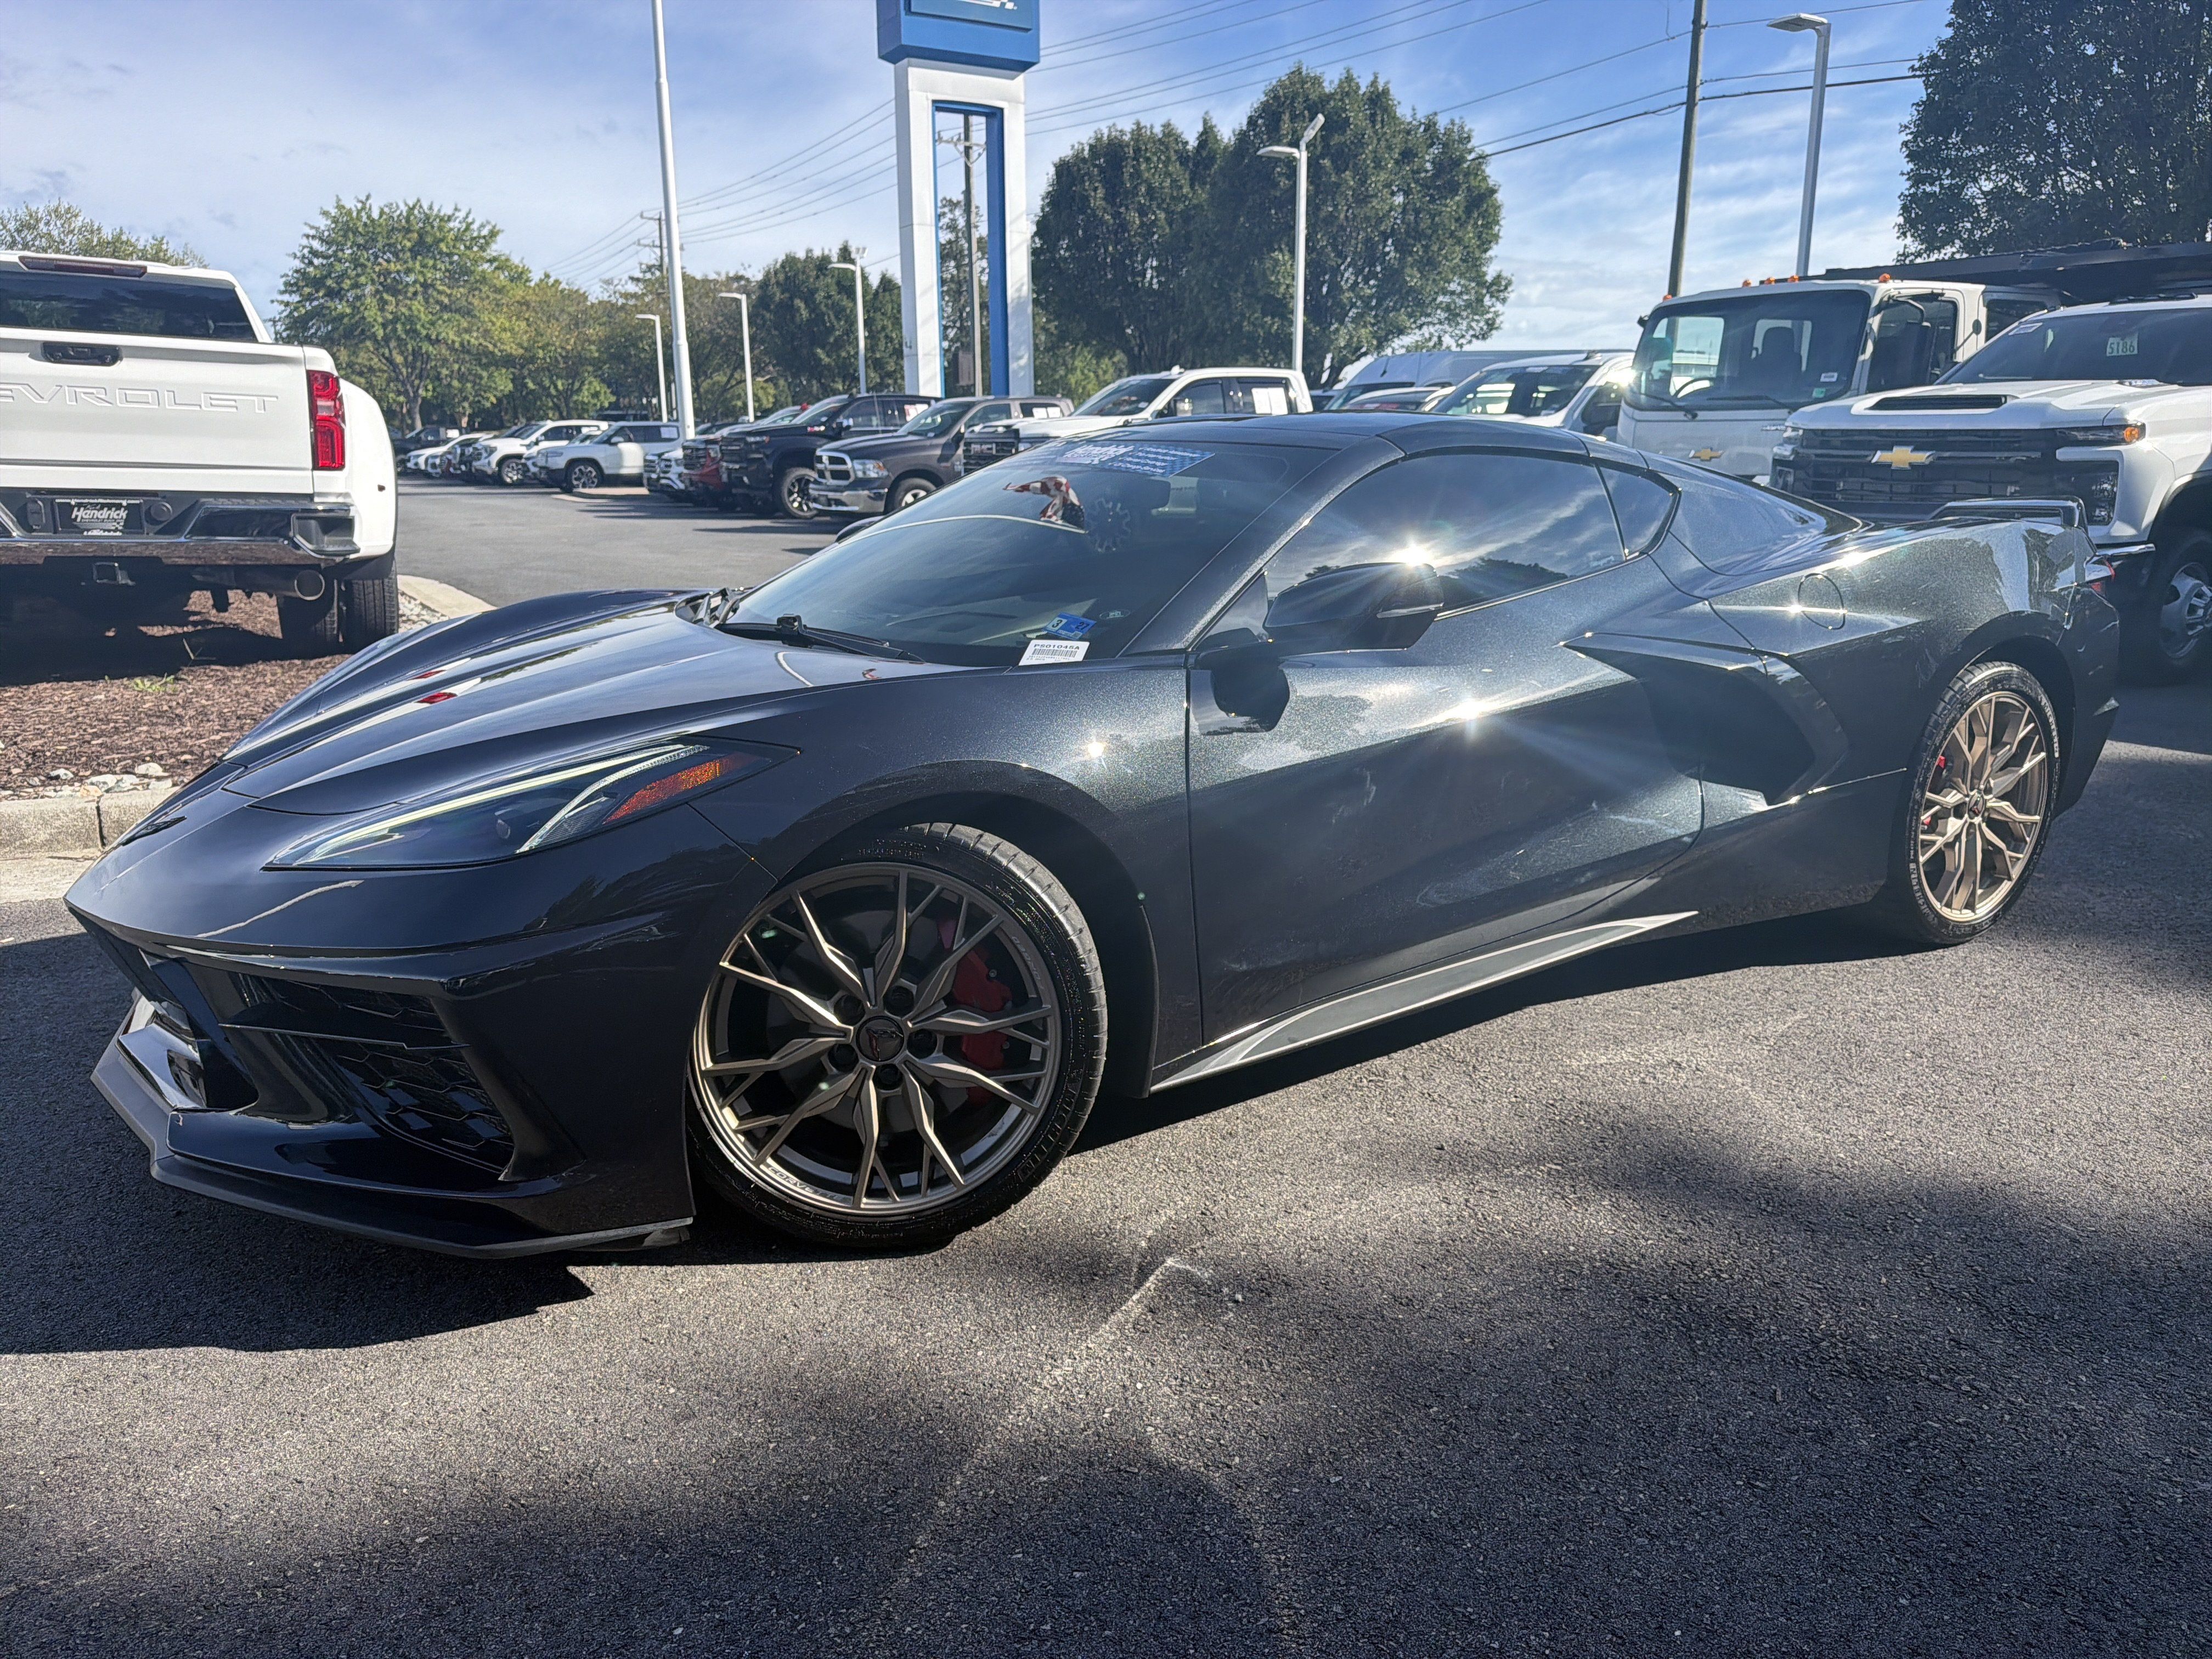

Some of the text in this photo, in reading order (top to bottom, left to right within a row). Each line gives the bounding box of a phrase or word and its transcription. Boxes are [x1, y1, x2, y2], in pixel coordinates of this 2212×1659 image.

[2108, 341, 2135, 354] 5186
[1052, 619, 1063, 628] 3
[1075, 622, 1090, 630] 27
[768, 1167, 843, 1200] CORVETTE
